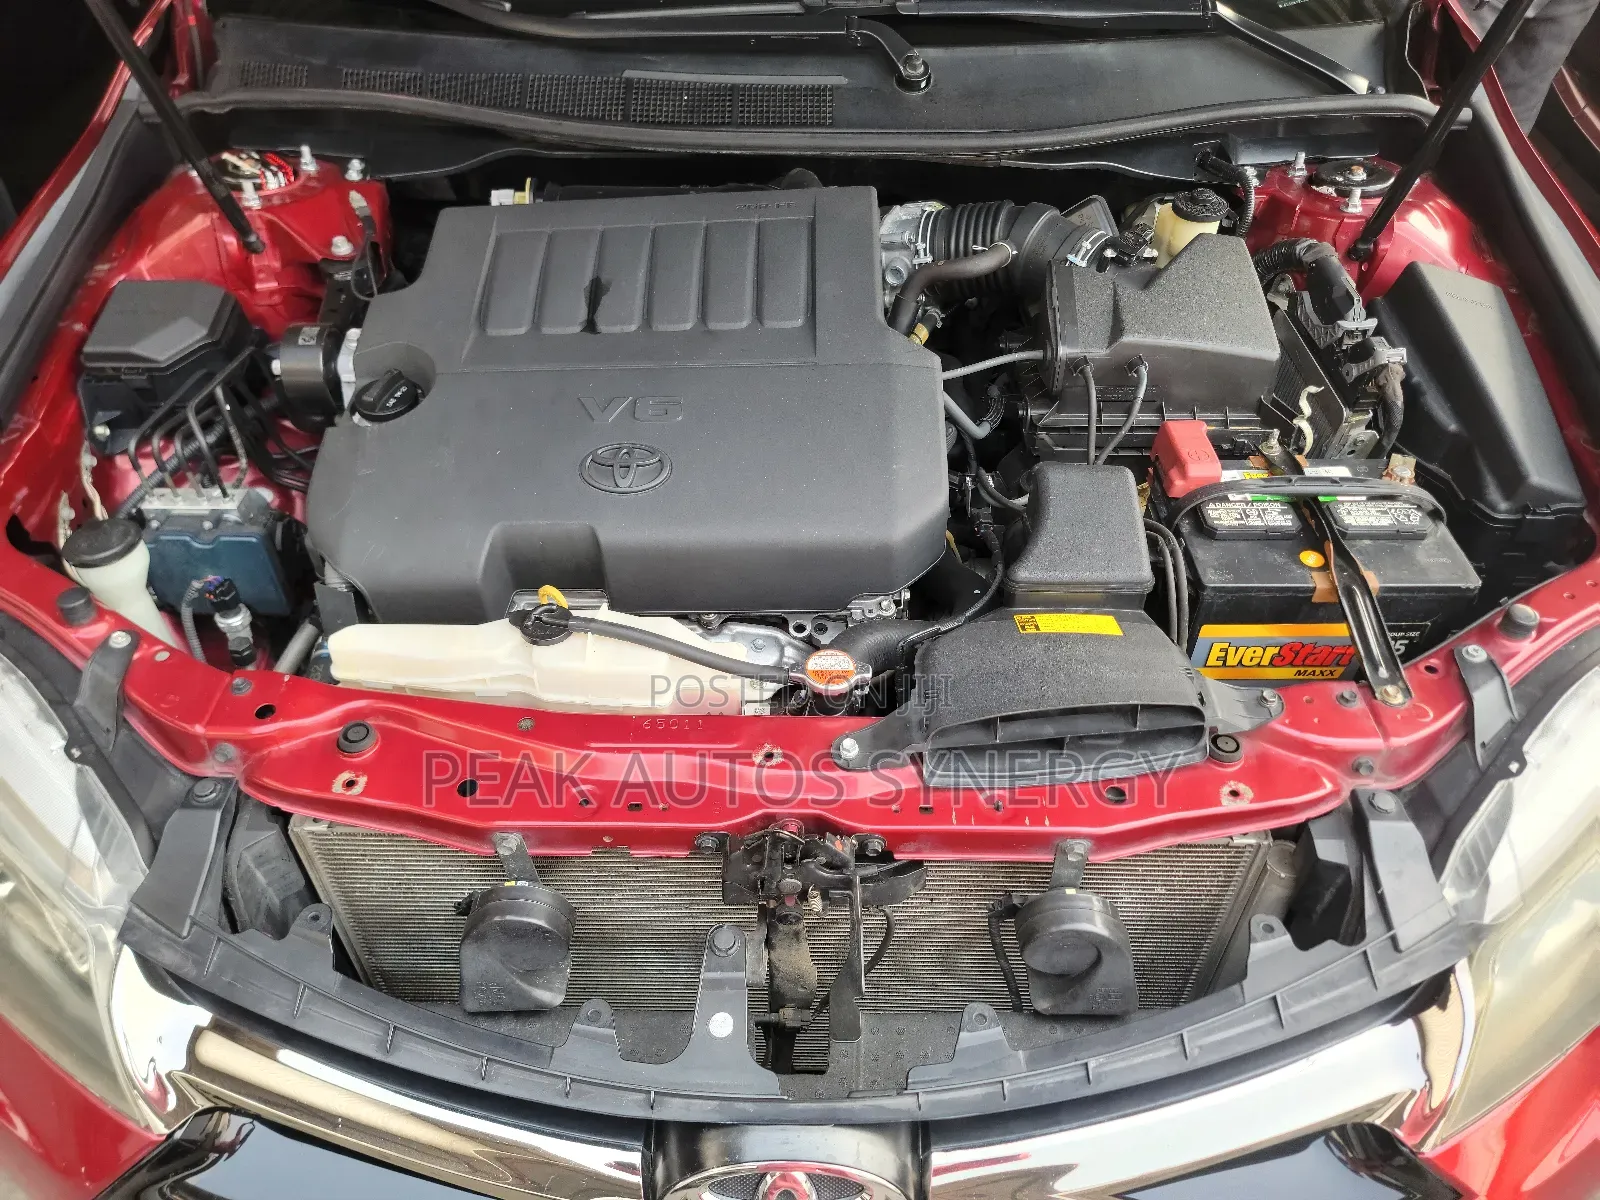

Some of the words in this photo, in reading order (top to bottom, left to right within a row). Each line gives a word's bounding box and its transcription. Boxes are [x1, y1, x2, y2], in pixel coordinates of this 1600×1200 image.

[577, 395, 684, 424] V6
[1294, 669, 1337, 677] MAXX
[642, 718, 703, 730] 65011
